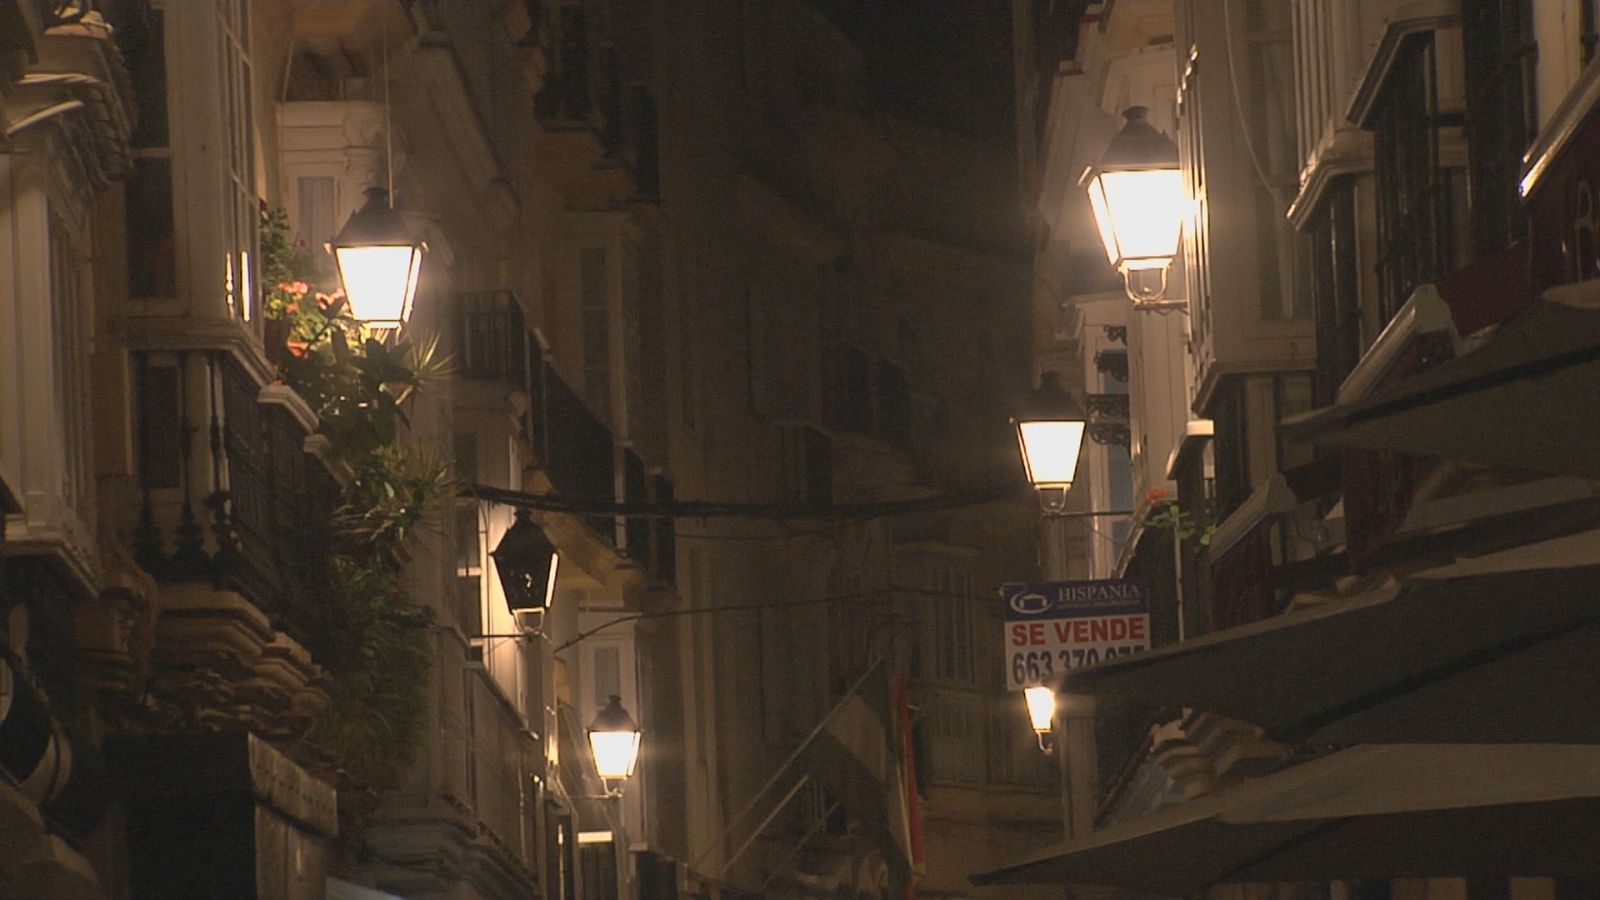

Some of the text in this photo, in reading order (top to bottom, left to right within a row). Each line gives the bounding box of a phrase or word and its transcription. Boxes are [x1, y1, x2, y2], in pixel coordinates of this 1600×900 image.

[1058, 583, 1140, 601] HISPANIA
[1012, 616, 1145, 647] SE VENDE
[1012, 650, 1053, 685] 663
